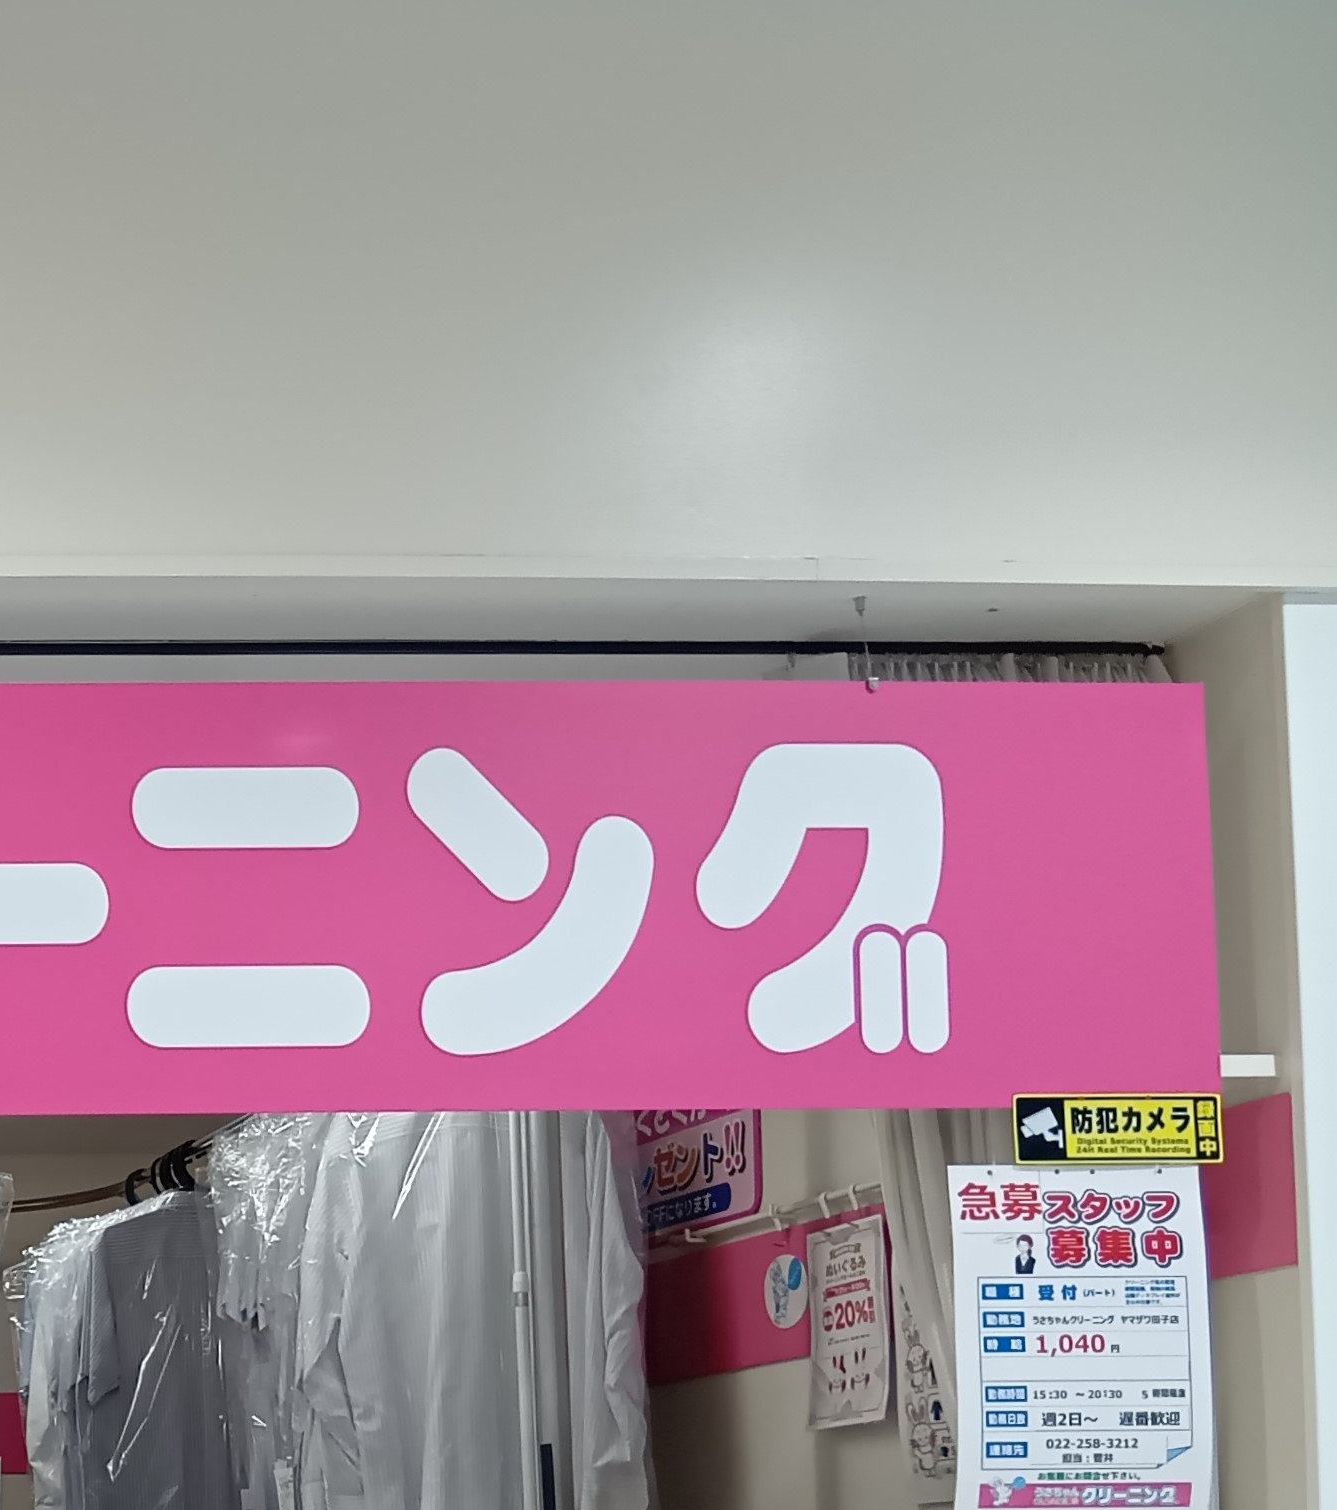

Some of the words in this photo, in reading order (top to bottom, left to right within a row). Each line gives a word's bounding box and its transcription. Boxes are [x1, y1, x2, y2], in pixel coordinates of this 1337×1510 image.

[1070, 1106, 1191, 1134] 防犯カメラ
[1110, 1137, 1147, 1146] Security
[1152, 1137, 1189, 1146] Systems
[1145, 1146, 1191, 1154] Recording
[957, 1182, 1043, 1221] 急募
[1043, 1189, 1180, 1224] スタッフ
[1047, 1227, 1183, 1268] 募集中
[826, 1255, 867, 1278] ぬいぐるみ
[1038, 1284, 1077, 1302] 受付
[1082, 1288, 1116, 1298] (パート)
[834, 1299, 869, 1330] 20%
[1032, 1315, 1115, 1326] うさちゃんクリーニング
[1121, 1314, 1179, 1325] ヤマザワ田子店
[1035, 1334, 1106, 1357] 1,040
[1110, 1344, 1120, 1353] 円
[1033, 1389, 1068, 1400] 15:30
[1141, 1390, 1149, 1400] 5
[1118, 1411, 1181, 1427] 遅番歓迎
[1045, 1438, 1139, 1450] 022-258-3212
[1082, 1487, 1176, 1505] クリーニング
